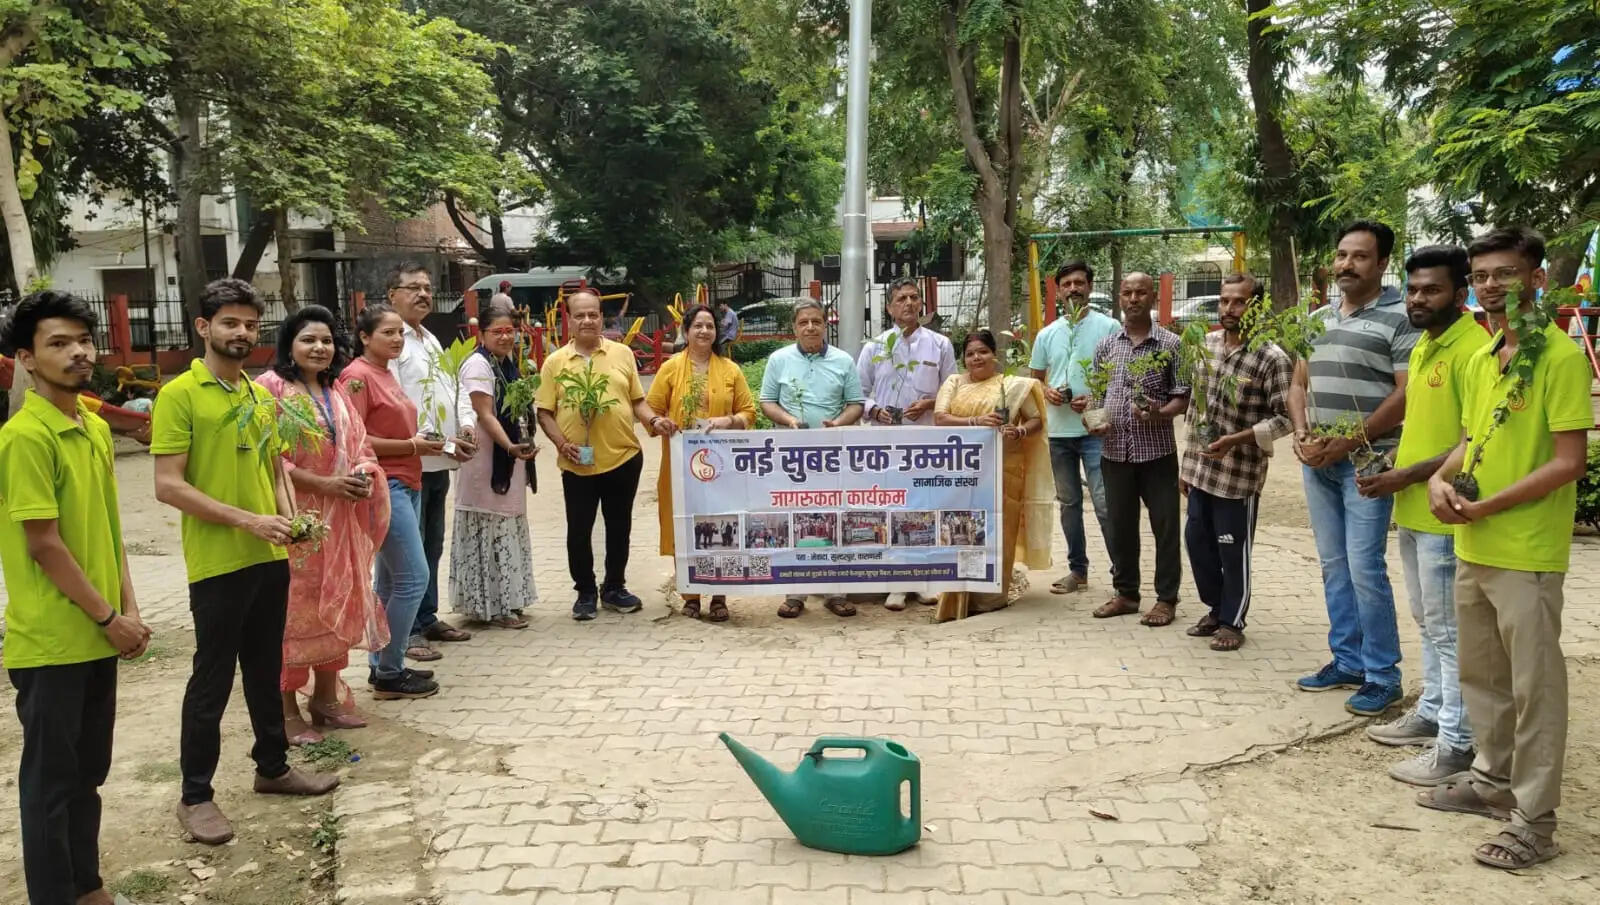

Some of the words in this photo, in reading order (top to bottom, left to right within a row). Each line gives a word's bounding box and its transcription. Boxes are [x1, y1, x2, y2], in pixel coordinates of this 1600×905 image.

[732, 438, 774, 476] नई
[779, 446, 842, 482] सुबह
[846, 445, 891, 472] एक
[896, 435, 983, 471] उम्मीद
[913, 475, 953, 488] सामाजिक
[954, 475, 978, 487] संस्था
[846, 485, 907, 506] कार्यक्रम
